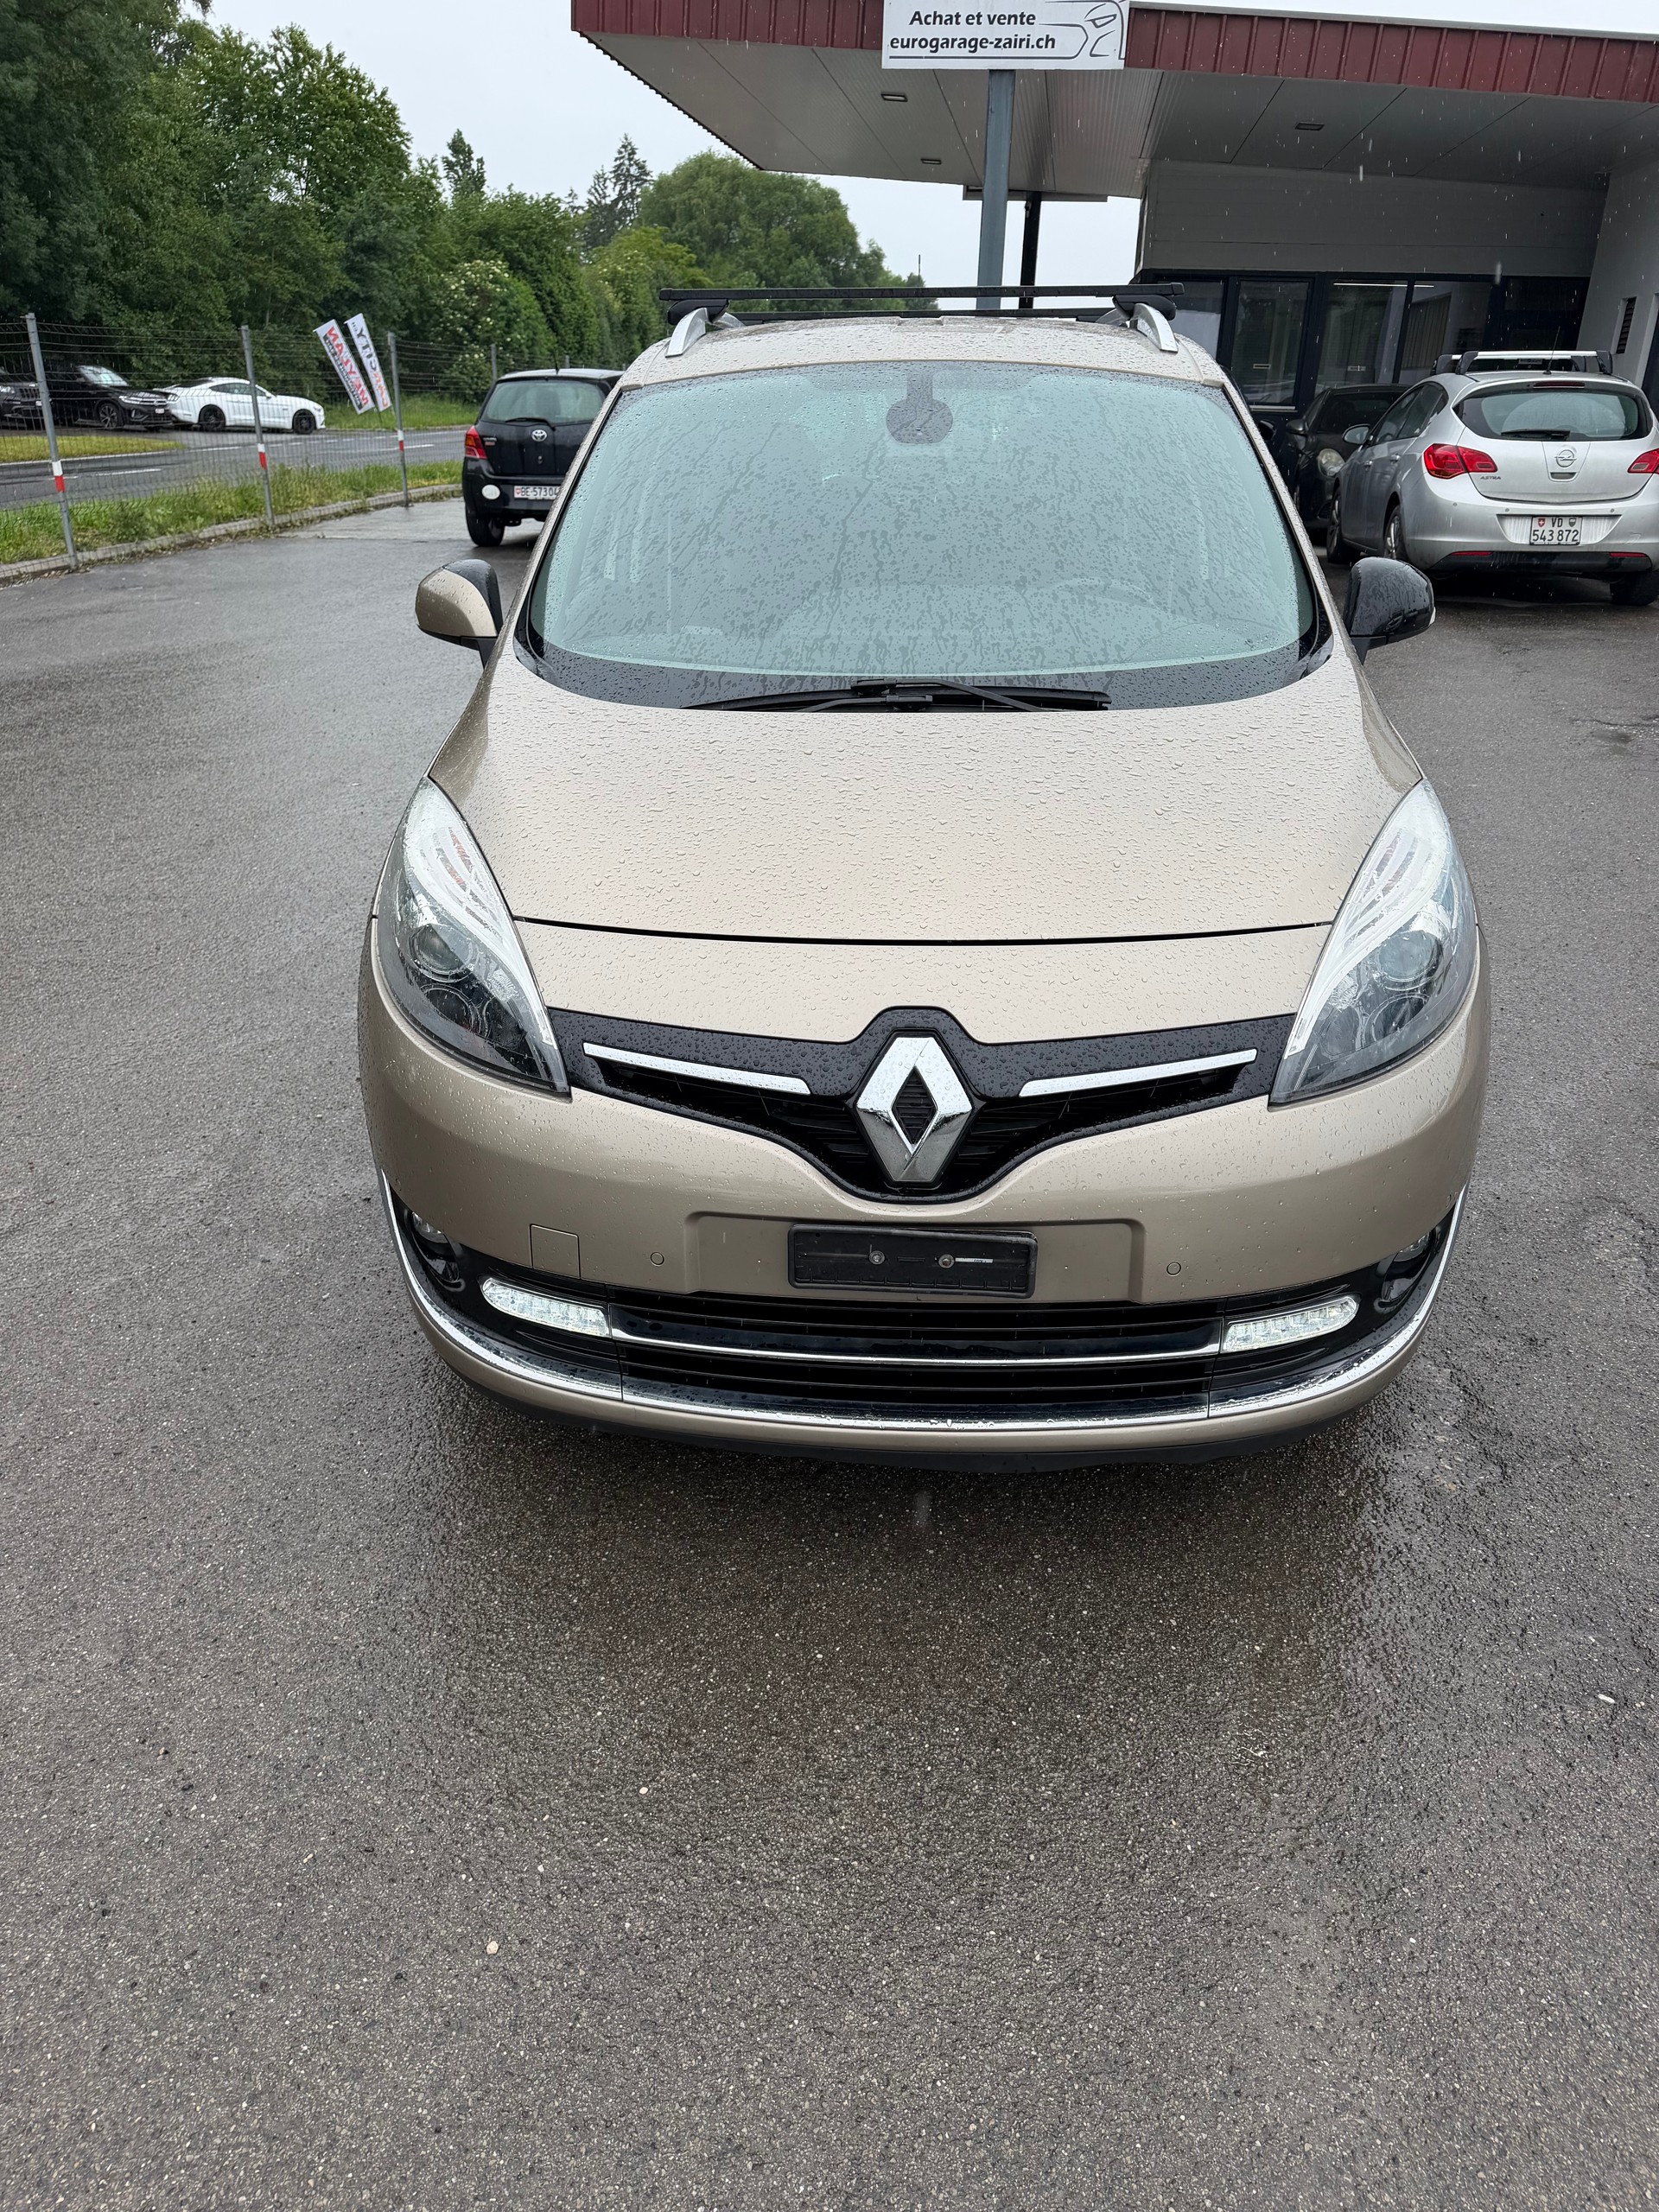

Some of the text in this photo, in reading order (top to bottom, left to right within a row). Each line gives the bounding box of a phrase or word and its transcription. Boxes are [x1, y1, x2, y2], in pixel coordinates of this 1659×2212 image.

[909, 10, 1036, 25] Achat et vente
[890, 34, 1056, 54] eurogarage-zairi.ch
[1551, 518, 1563, 528] VD
[1532, 529, 1580, 542] 543 872
